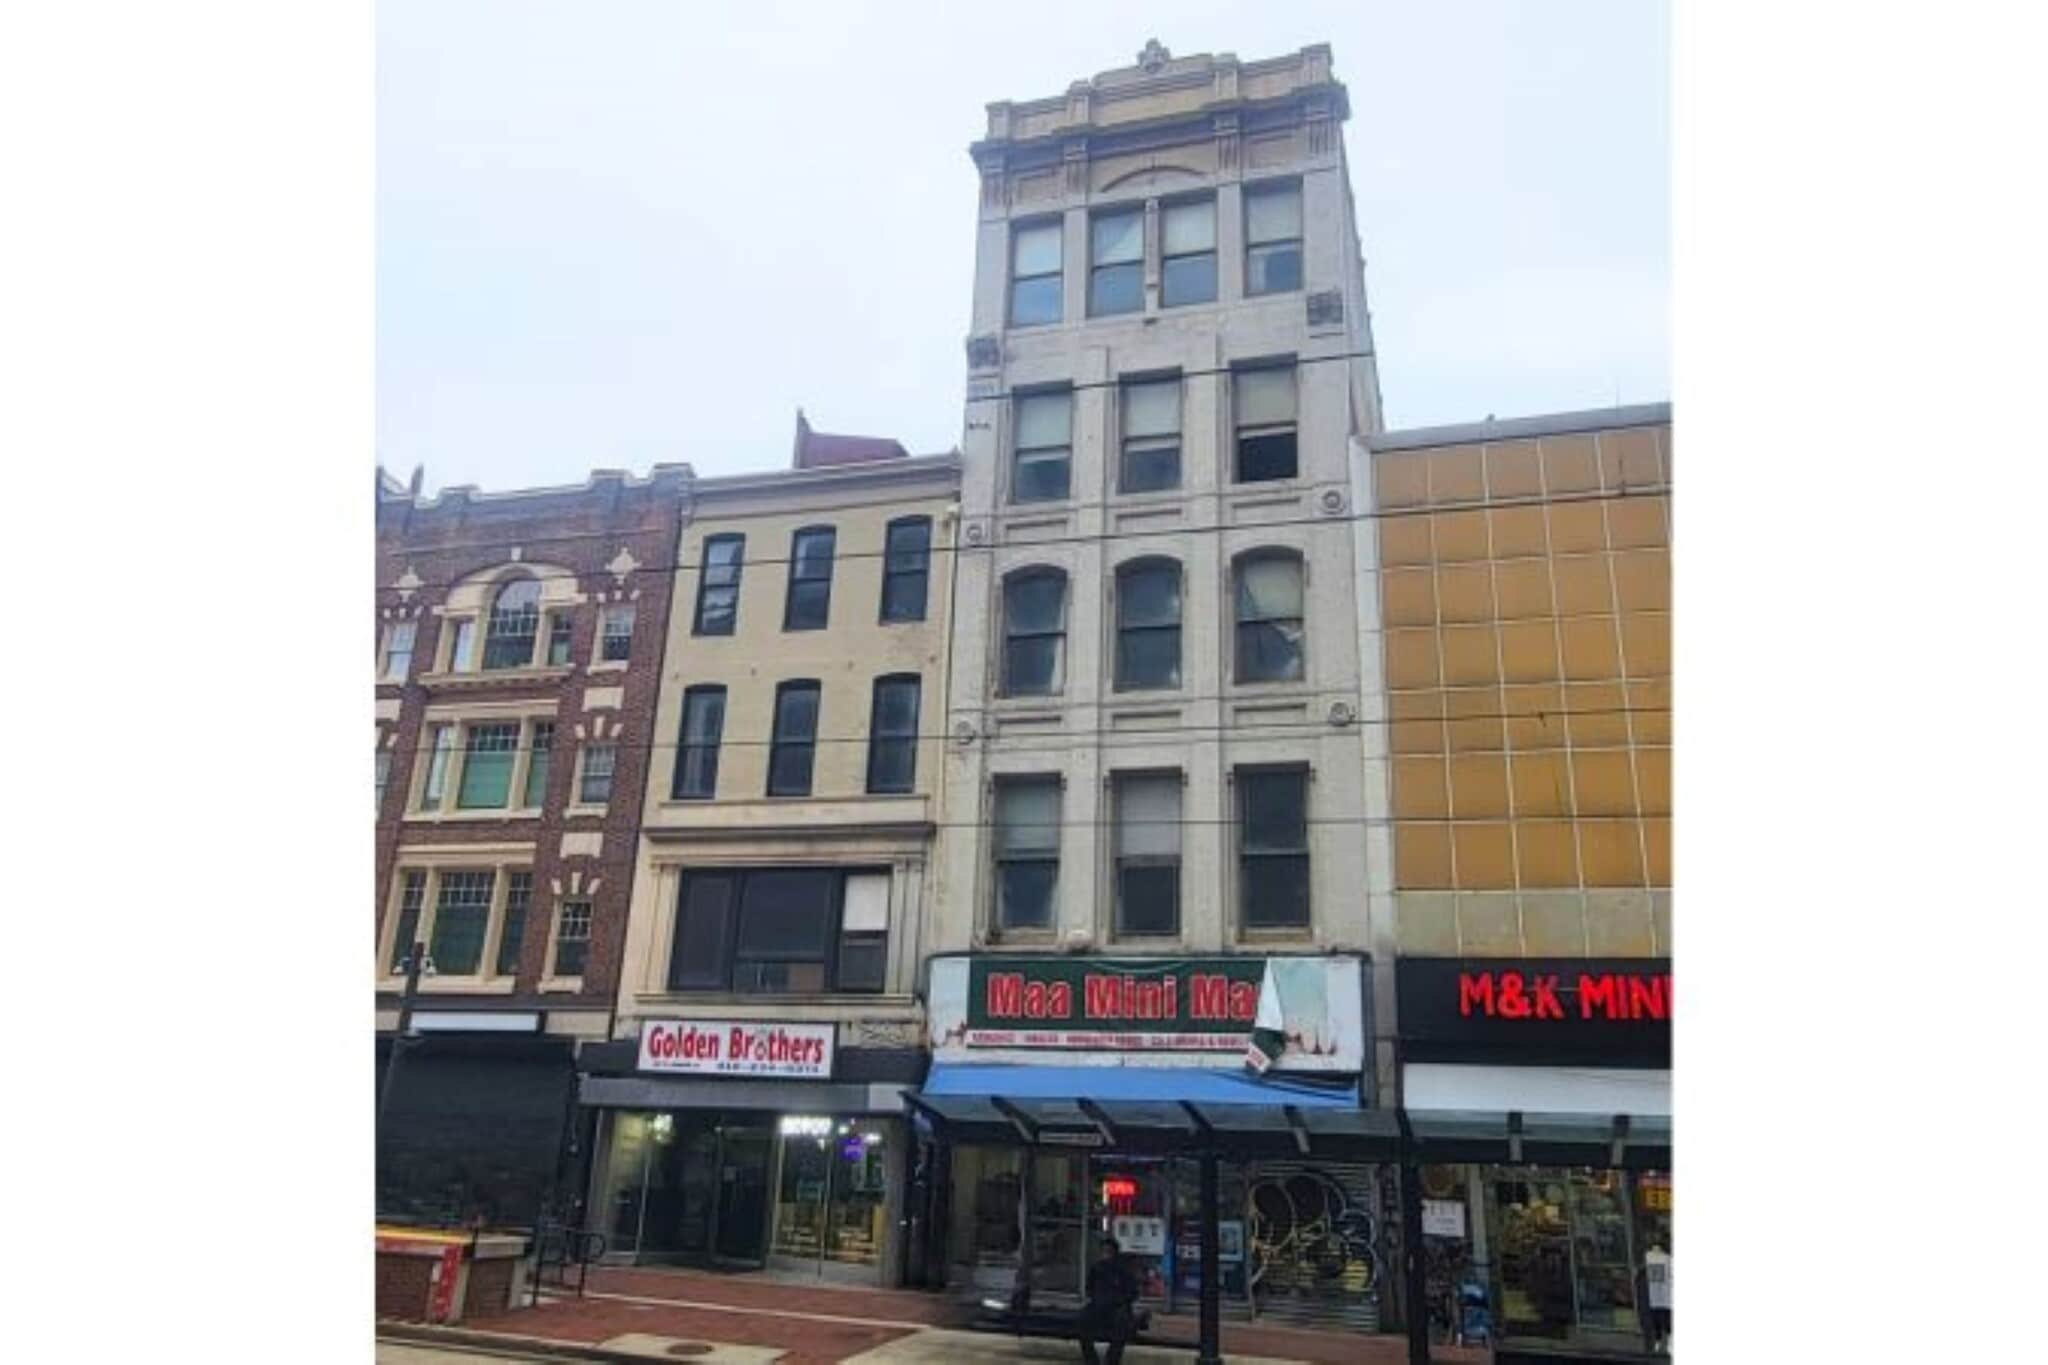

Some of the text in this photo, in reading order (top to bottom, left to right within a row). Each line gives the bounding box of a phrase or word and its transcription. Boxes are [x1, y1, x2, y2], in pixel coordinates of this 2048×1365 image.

[987, 973, 1259, 1019] Maa Mini Ma
[1459, 971, 1565, 1018] M&K
[649, 1025, 825, 1064] Golden Brothers
